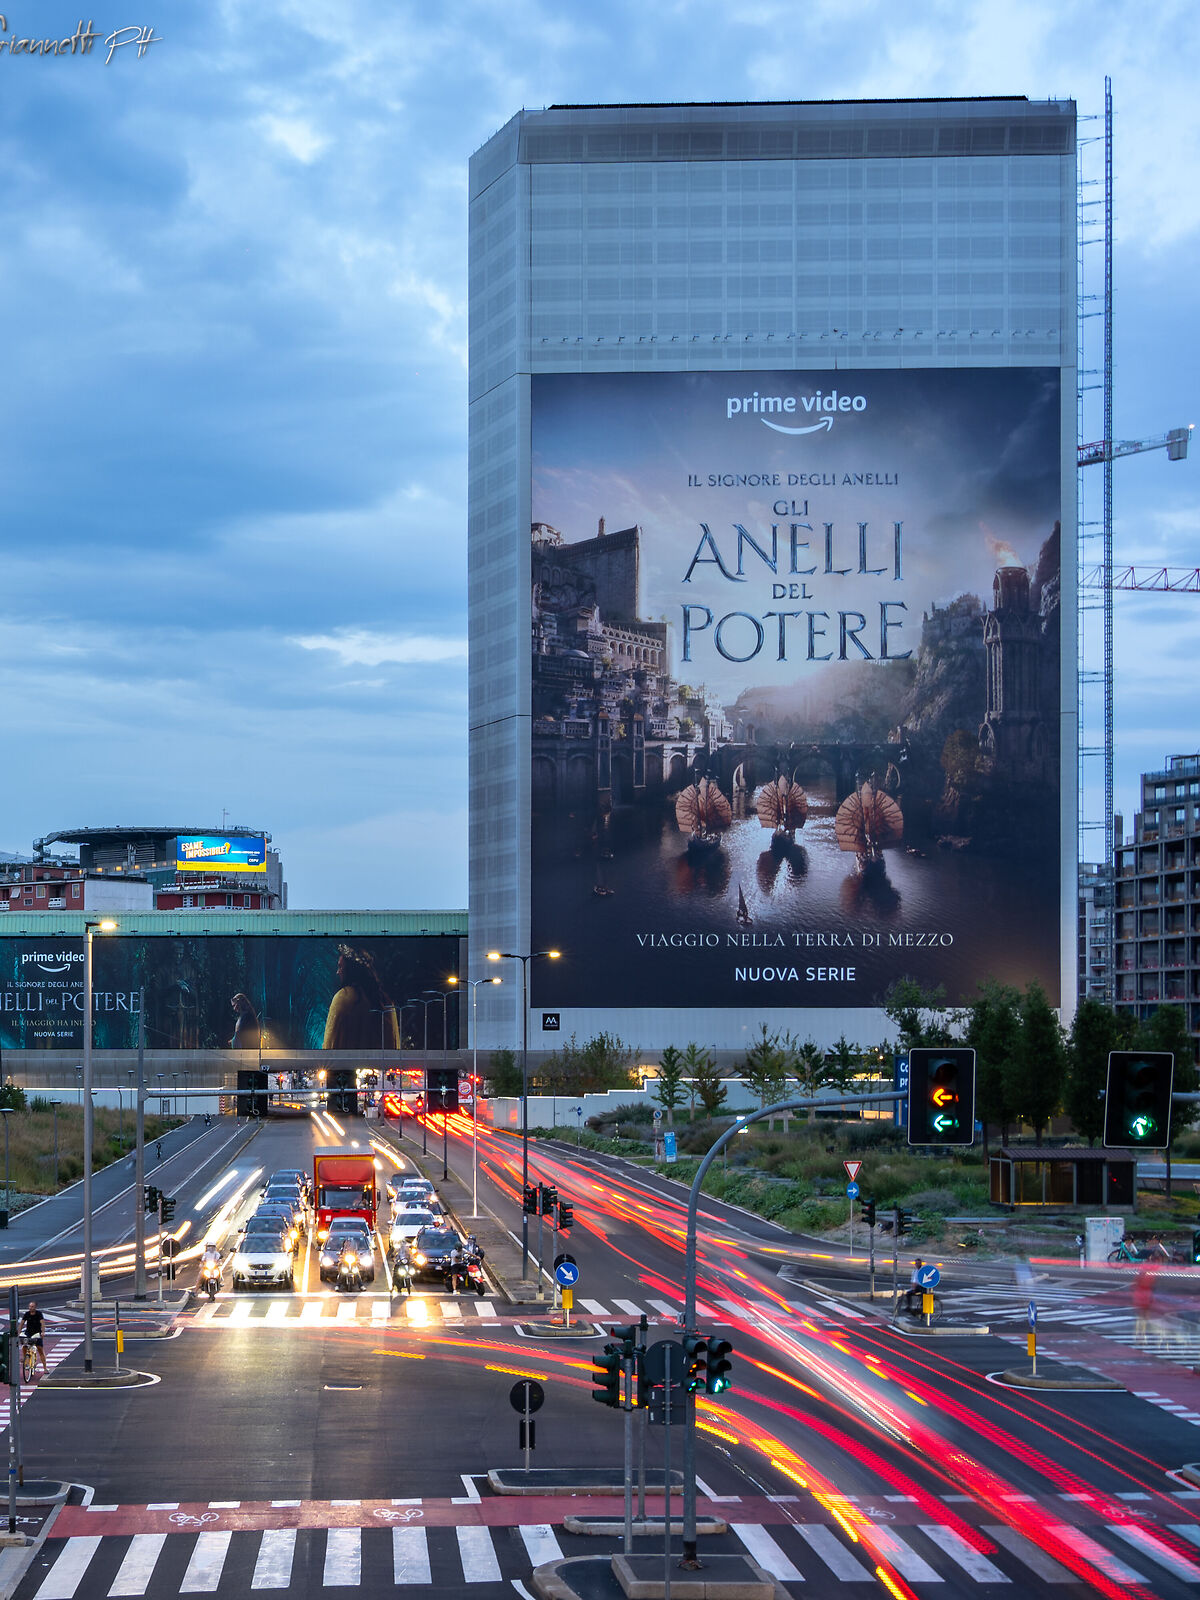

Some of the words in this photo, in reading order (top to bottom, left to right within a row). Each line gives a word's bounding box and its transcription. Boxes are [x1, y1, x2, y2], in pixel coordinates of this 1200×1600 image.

[726, 391, 796, 419] prime
[801, 389, 867, 413] video
[687, 474, 703, 487] IL
[708, 473, 781, 487] SIGNORE
[787, 473, 836, 487] DEGLI
[842, 473, 899, 486] ANELLI
[773, 499, 808, 517] GLI
[681, 520, 904, 583] ANELLI
[772, 582, 813, 600] DEL
[680, 601, 913, 663] POTERE
[181, 841, 204, 852] ESAME
[636, 933, 720, 947] VIAGGIO
[726, 933, 786, 947] NELLA
[791, 932, 854, 947] TERRA
[861, 932, 881, 947] DI
[888, 932, 954, 947] MEZZO
[21, 952, 54, 965] prime
[55, 951, 85, 962] video
[734, 967, 799, 982] NUOVA
[805, 966, 856, 982] SERIE
[61, 991, 141, 1014] POTERE
[21, 1019, 55, 1027] VIAGGIO
[57, 1019, 69, 1027] HA
